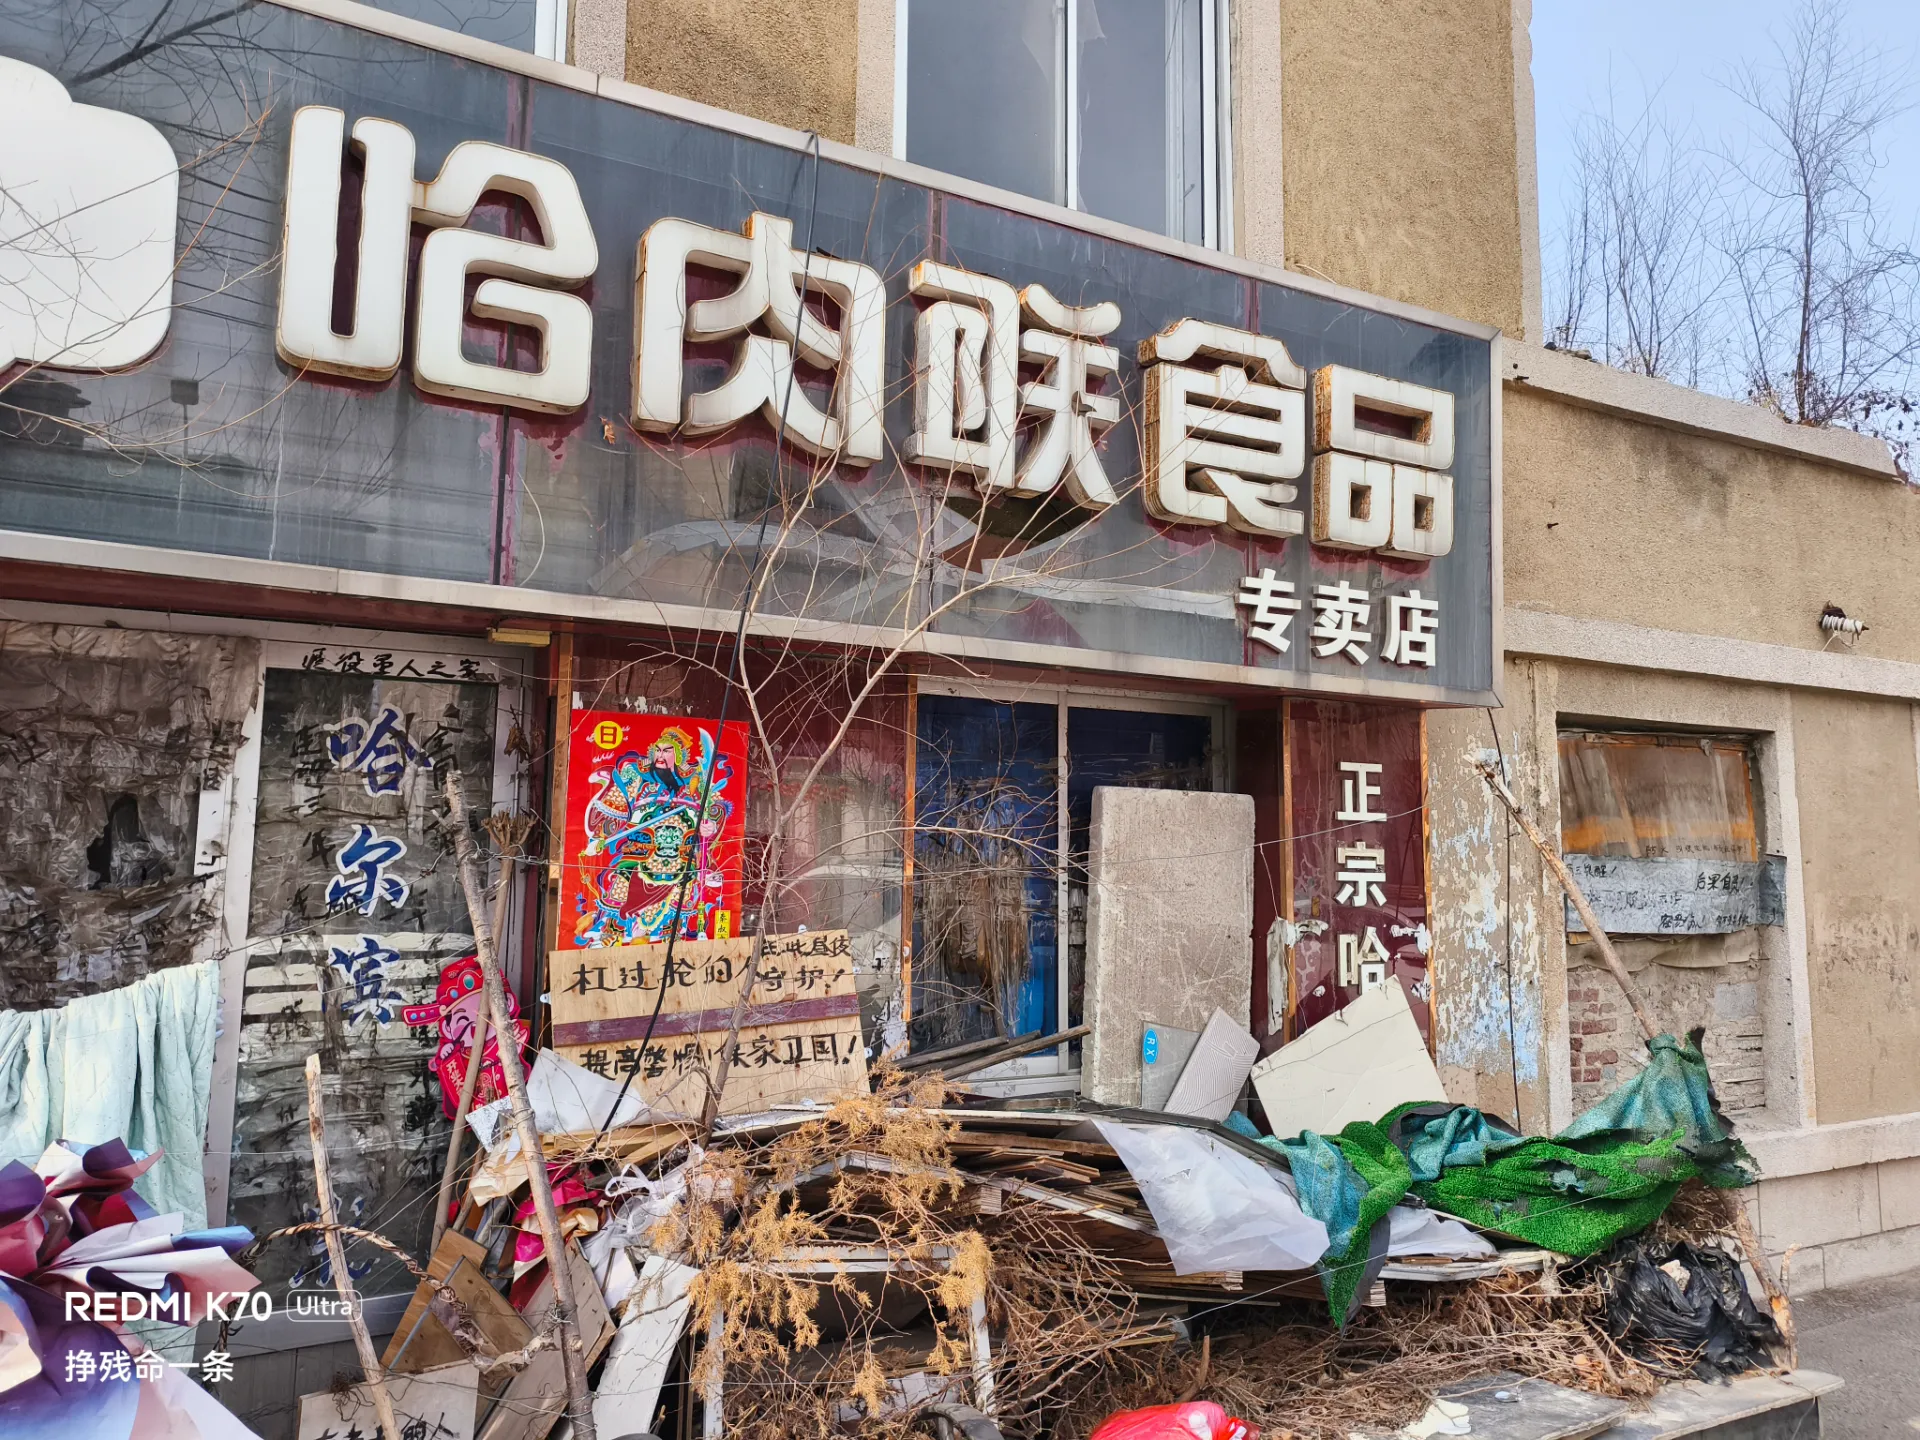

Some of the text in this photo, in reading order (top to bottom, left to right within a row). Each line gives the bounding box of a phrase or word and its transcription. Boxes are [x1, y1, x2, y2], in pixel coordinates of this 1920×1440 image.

[1235, 567, 1440, 667] 专卖店
[600, 725, 618, 745] 日
[1335, 760, 1390, 995] 正宗哈
[1146, 1037, 1156, 1057] RX
